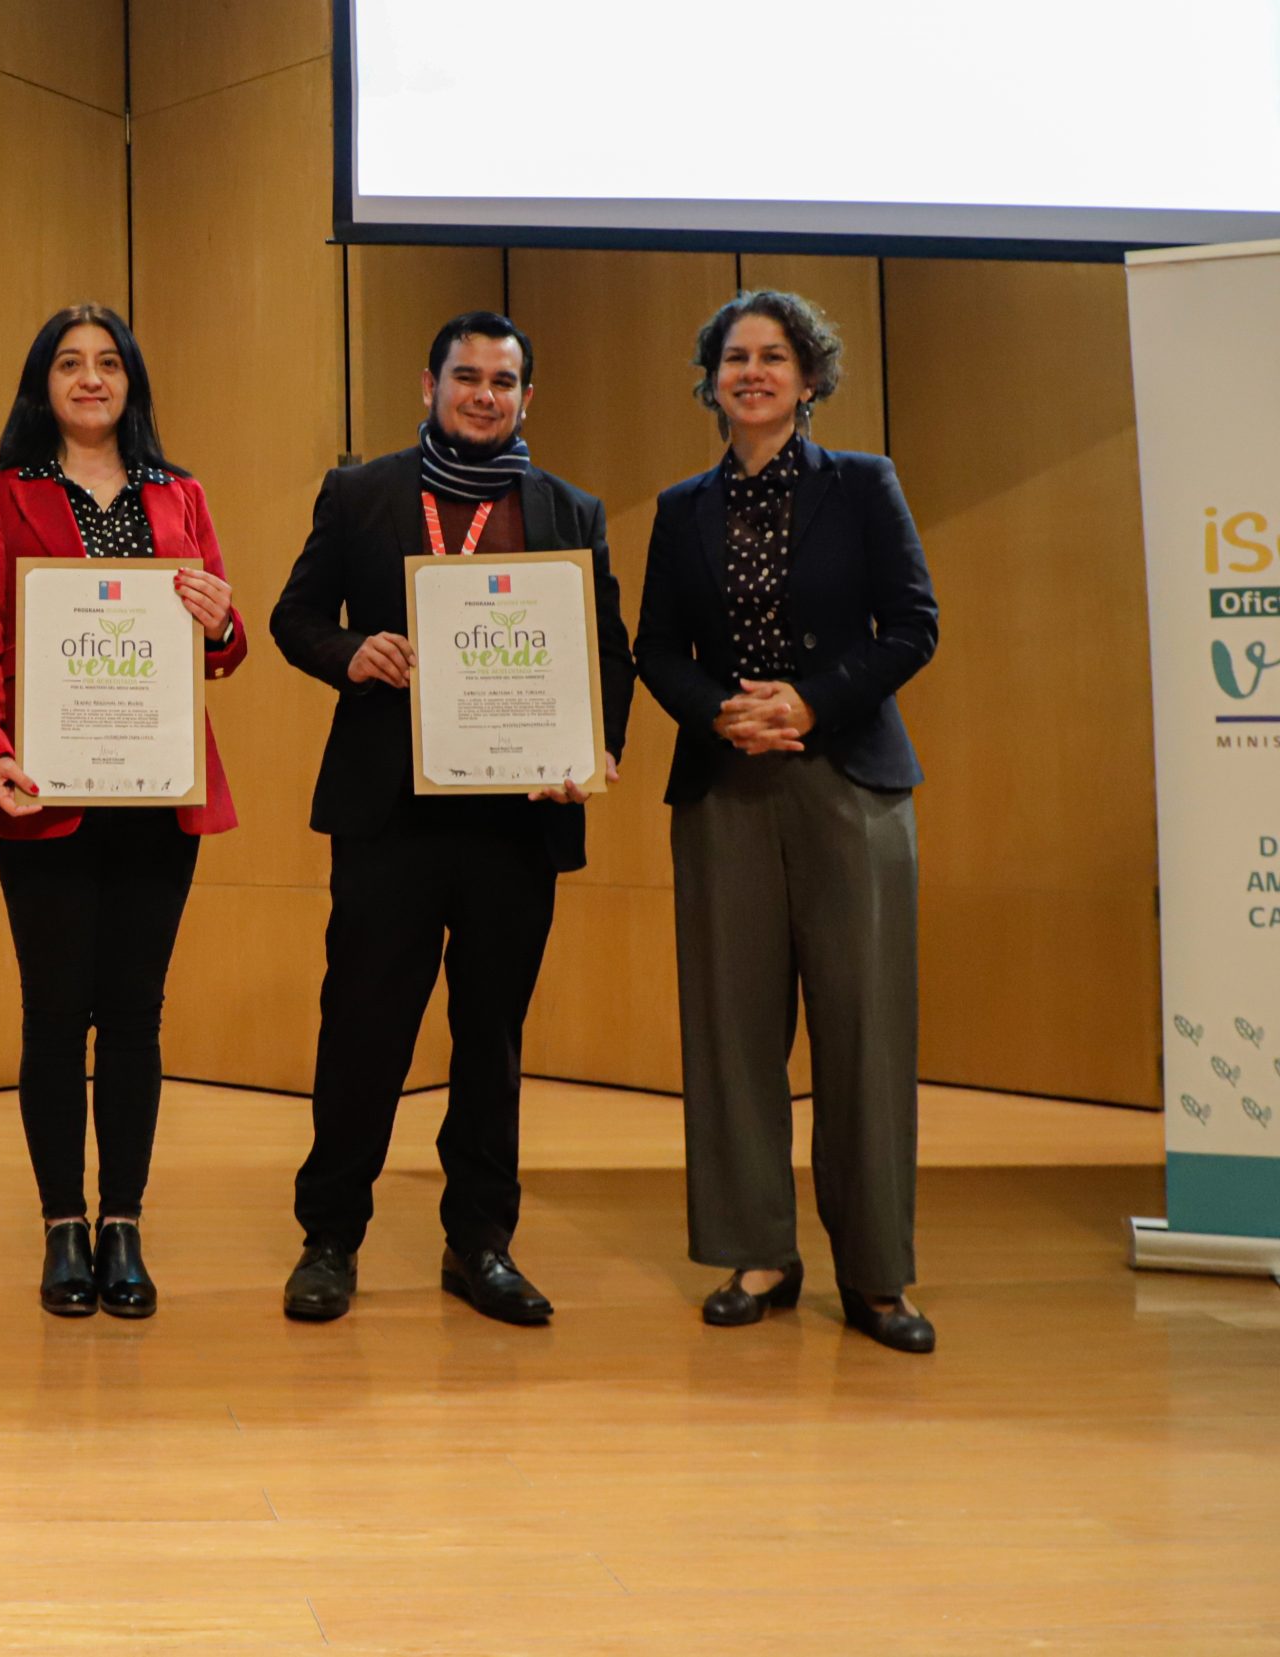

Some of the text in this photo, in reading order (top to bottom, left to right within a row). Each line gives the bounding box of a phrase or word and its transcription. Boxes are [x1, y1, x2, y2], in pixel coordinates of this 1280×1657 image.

[1204, 506, 1280, 574] iS
[61, 617, 153, 659] oficina
[454, 610, 546, 650] oficina
[67, 650, 158, 677] verde
[461, 640, 553, 667] verde
